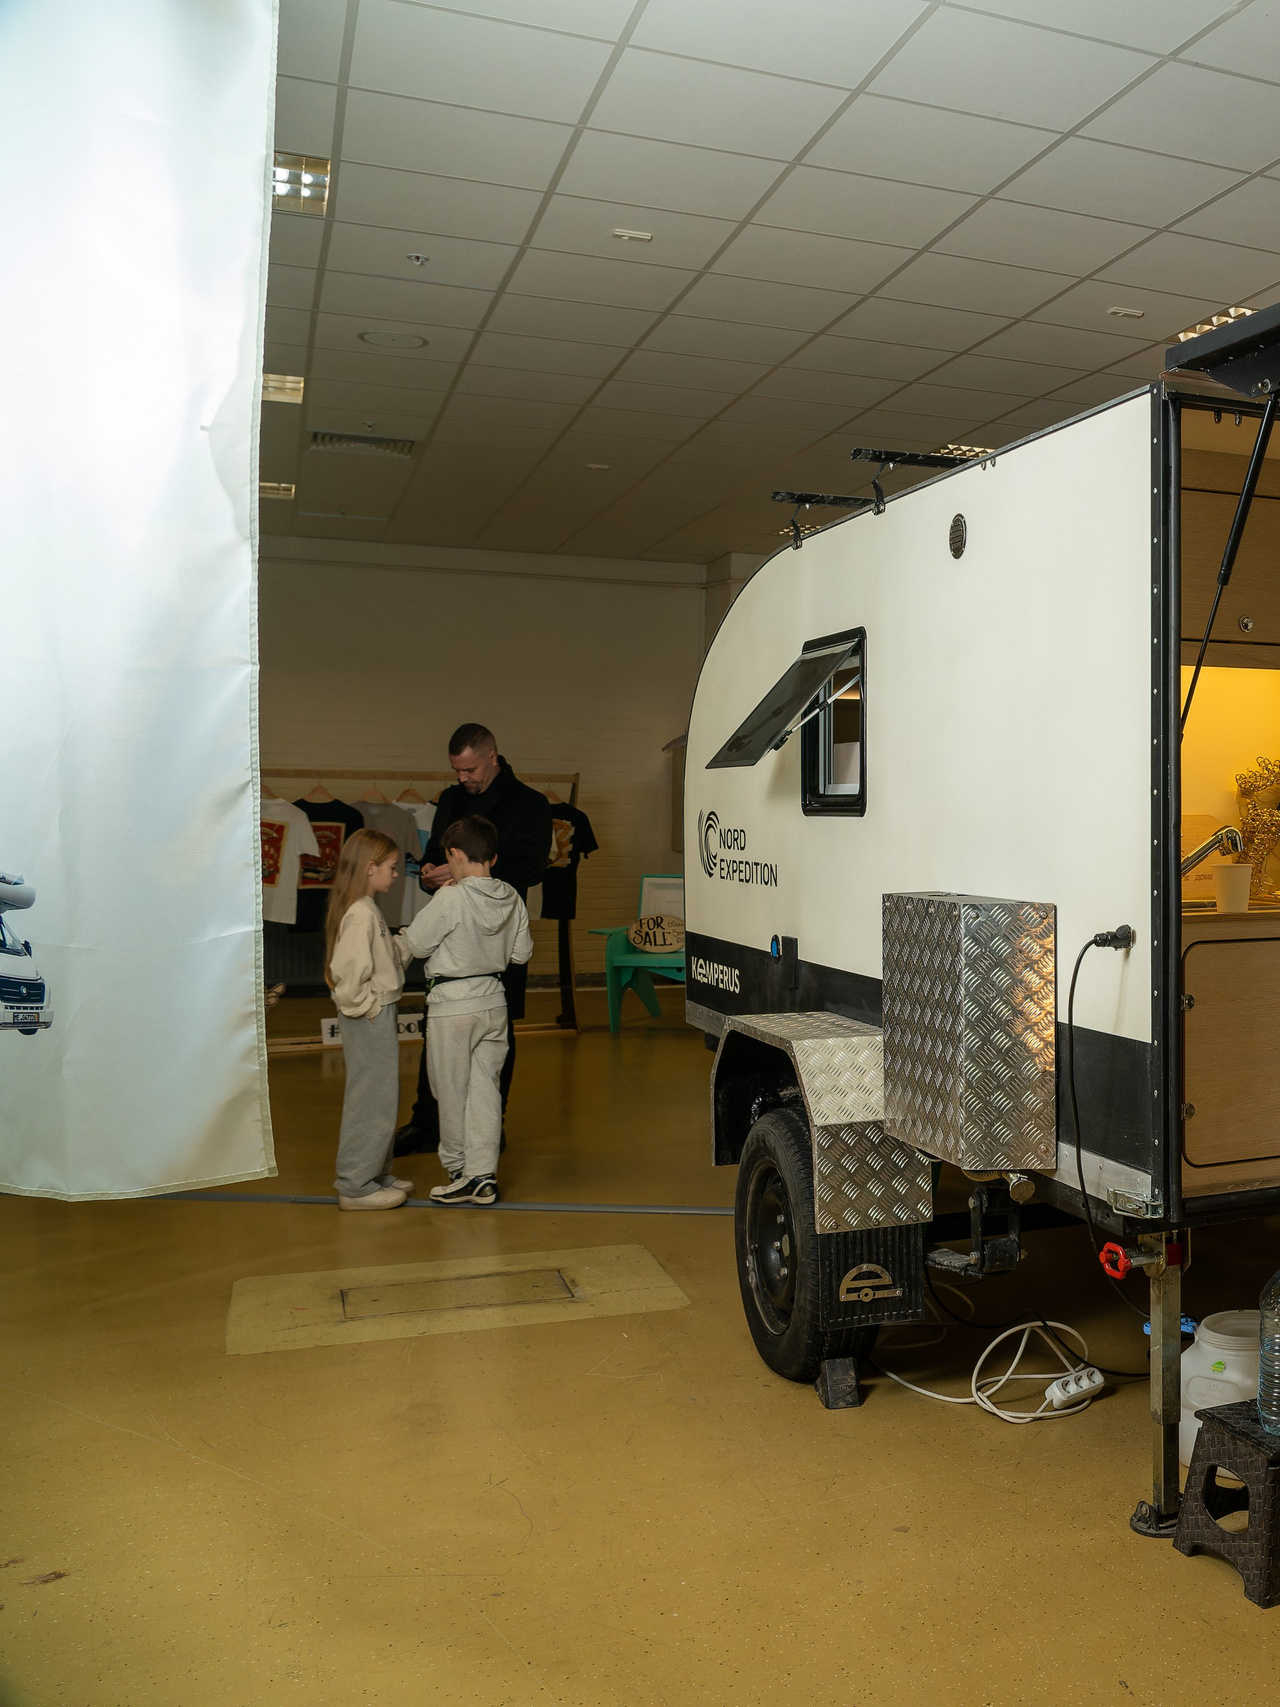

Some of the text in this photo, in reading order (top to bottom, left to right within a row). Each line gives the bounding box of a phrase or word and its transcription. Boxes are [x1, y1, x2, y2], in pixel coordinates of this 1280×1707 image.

[719, 828, 747, 851] NORD
[719, 858, 778, 887] EXPEDITION
[639, 915, 665, 930] FOR
[632, 929, 673, 947] SALE
